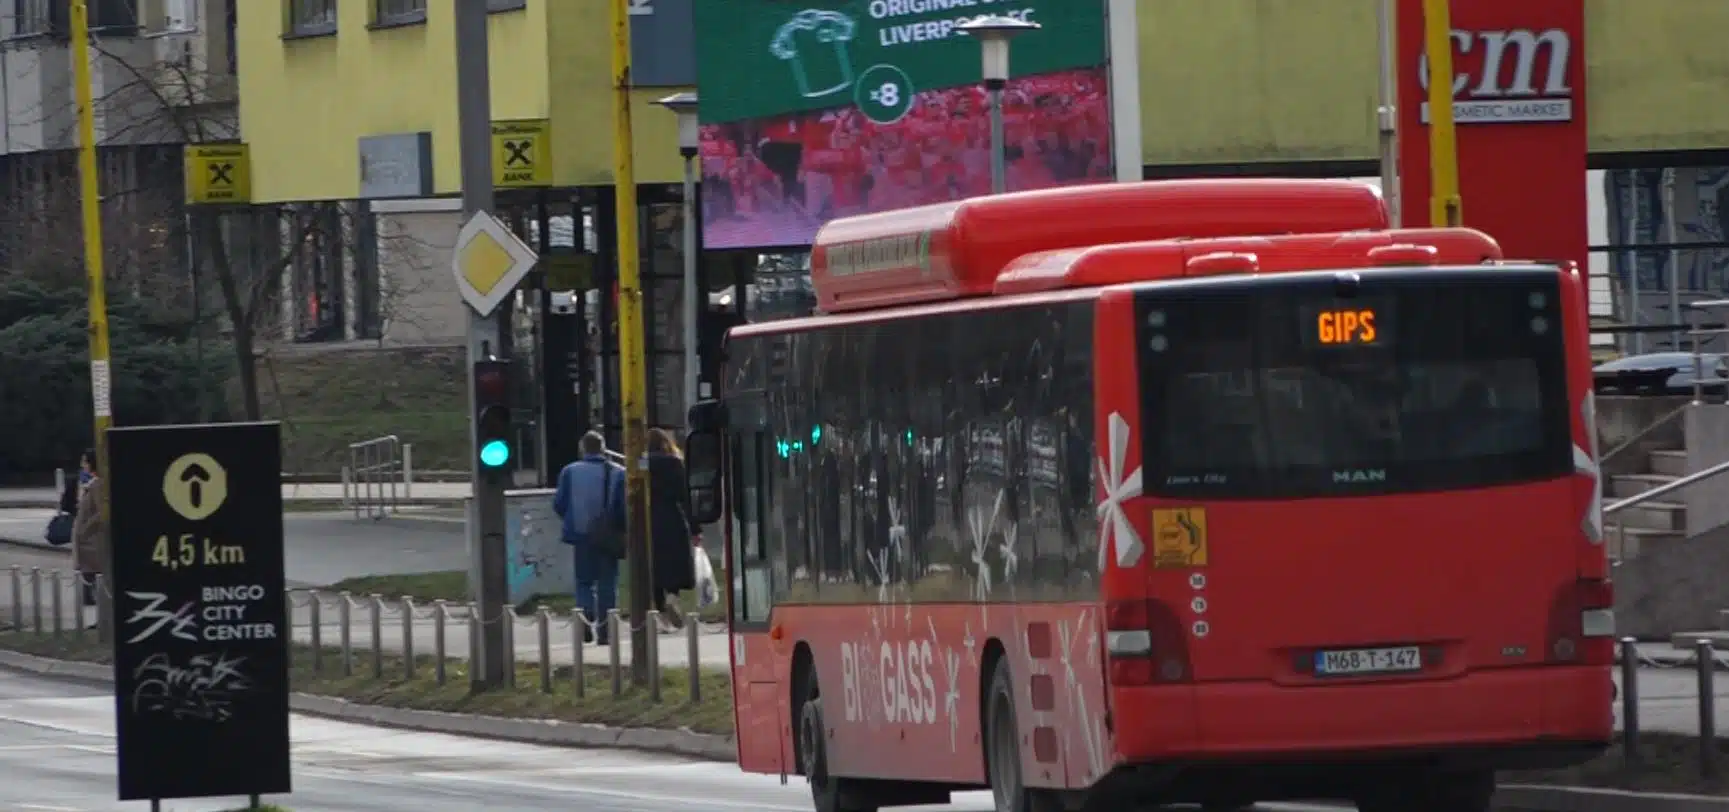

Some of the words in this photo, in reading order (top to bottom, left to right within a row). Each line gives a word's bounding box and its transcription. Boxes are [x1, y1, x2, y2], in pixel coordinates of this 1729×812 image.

[1507, 103, 1565, 117] MARKET
[1317, 309, 1377, 344] GIPS
[1331, 468, 1386, 484] MAN
[152, 534, 196, 571] 4,5
[204, 538, 246, 566] km
[202, 584, 266, 602] BINGO
[203, 604, 247, 622] CITY
[203, 623, 277, 641] CENTER
[1326, 649, 1417, 671] M68-T-147
